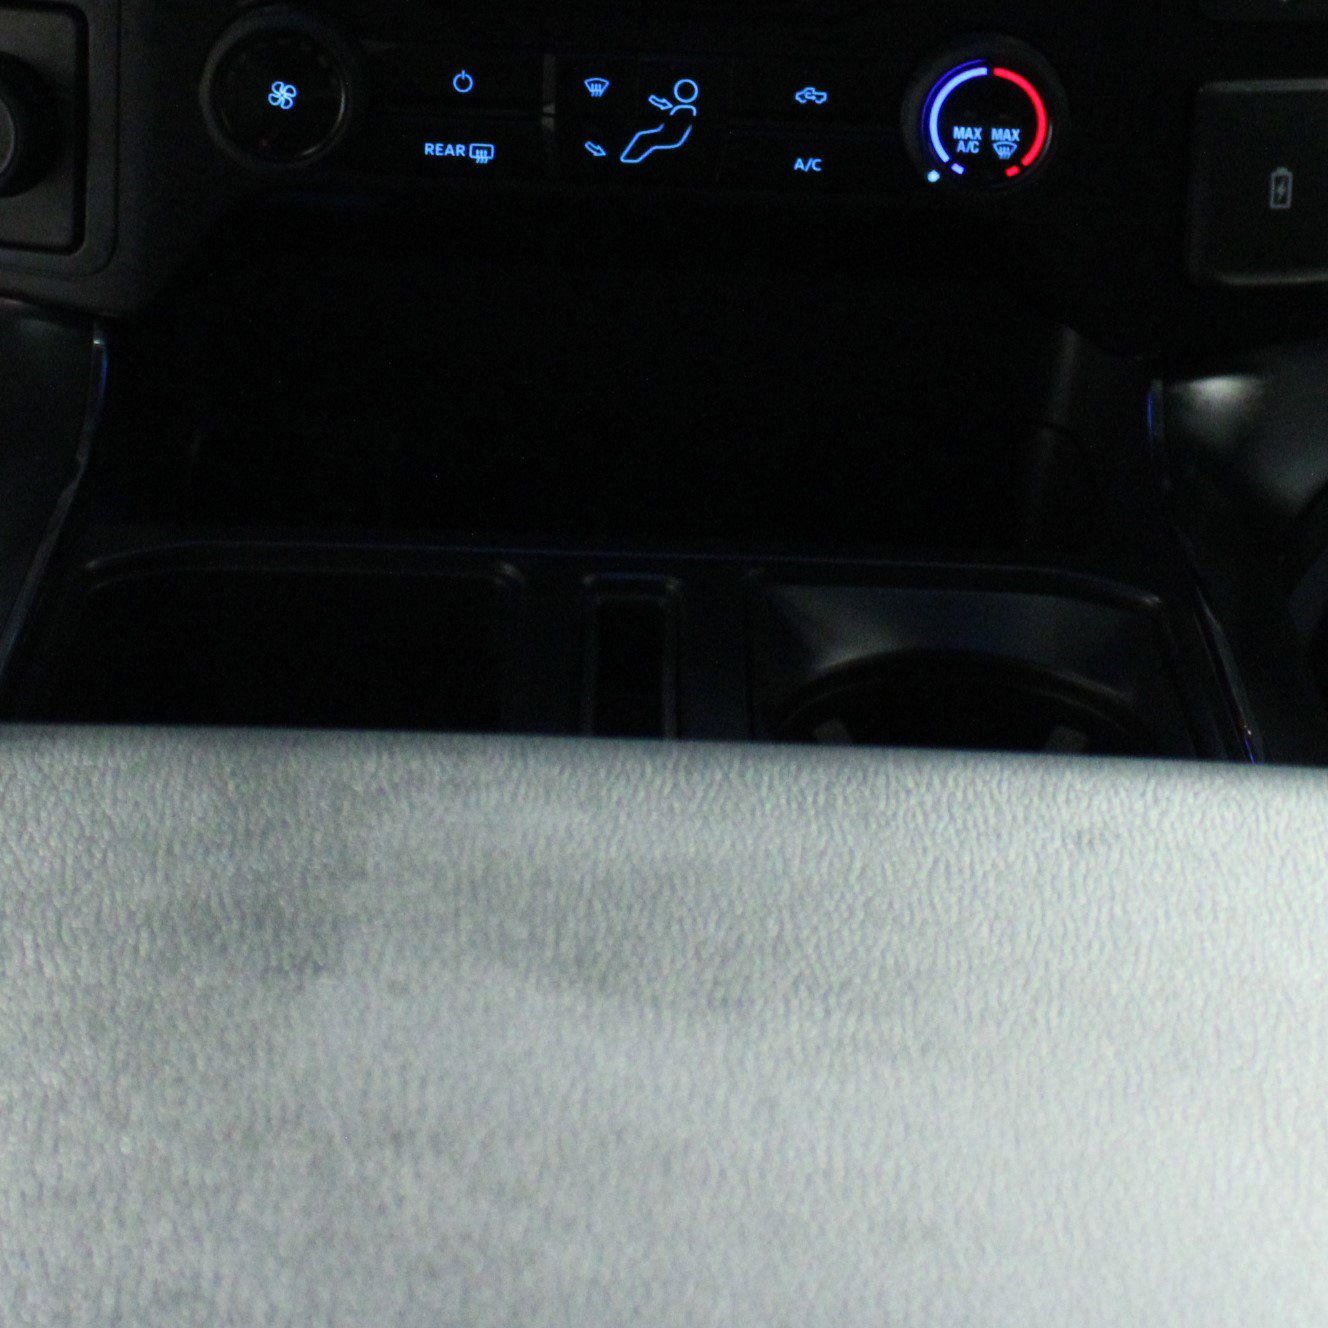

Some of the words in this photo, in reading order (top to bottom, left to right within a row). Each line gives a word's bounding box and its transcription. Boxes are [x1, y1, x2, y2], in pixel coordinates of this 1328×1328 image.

[953, 125, 982, 140] MAX
[991, 127, 1020, 142] MAX
[424, 143, 465, 157] REAR
[957, 140, 979, 153] A/C
[794, 158, 821, 171] A/C
